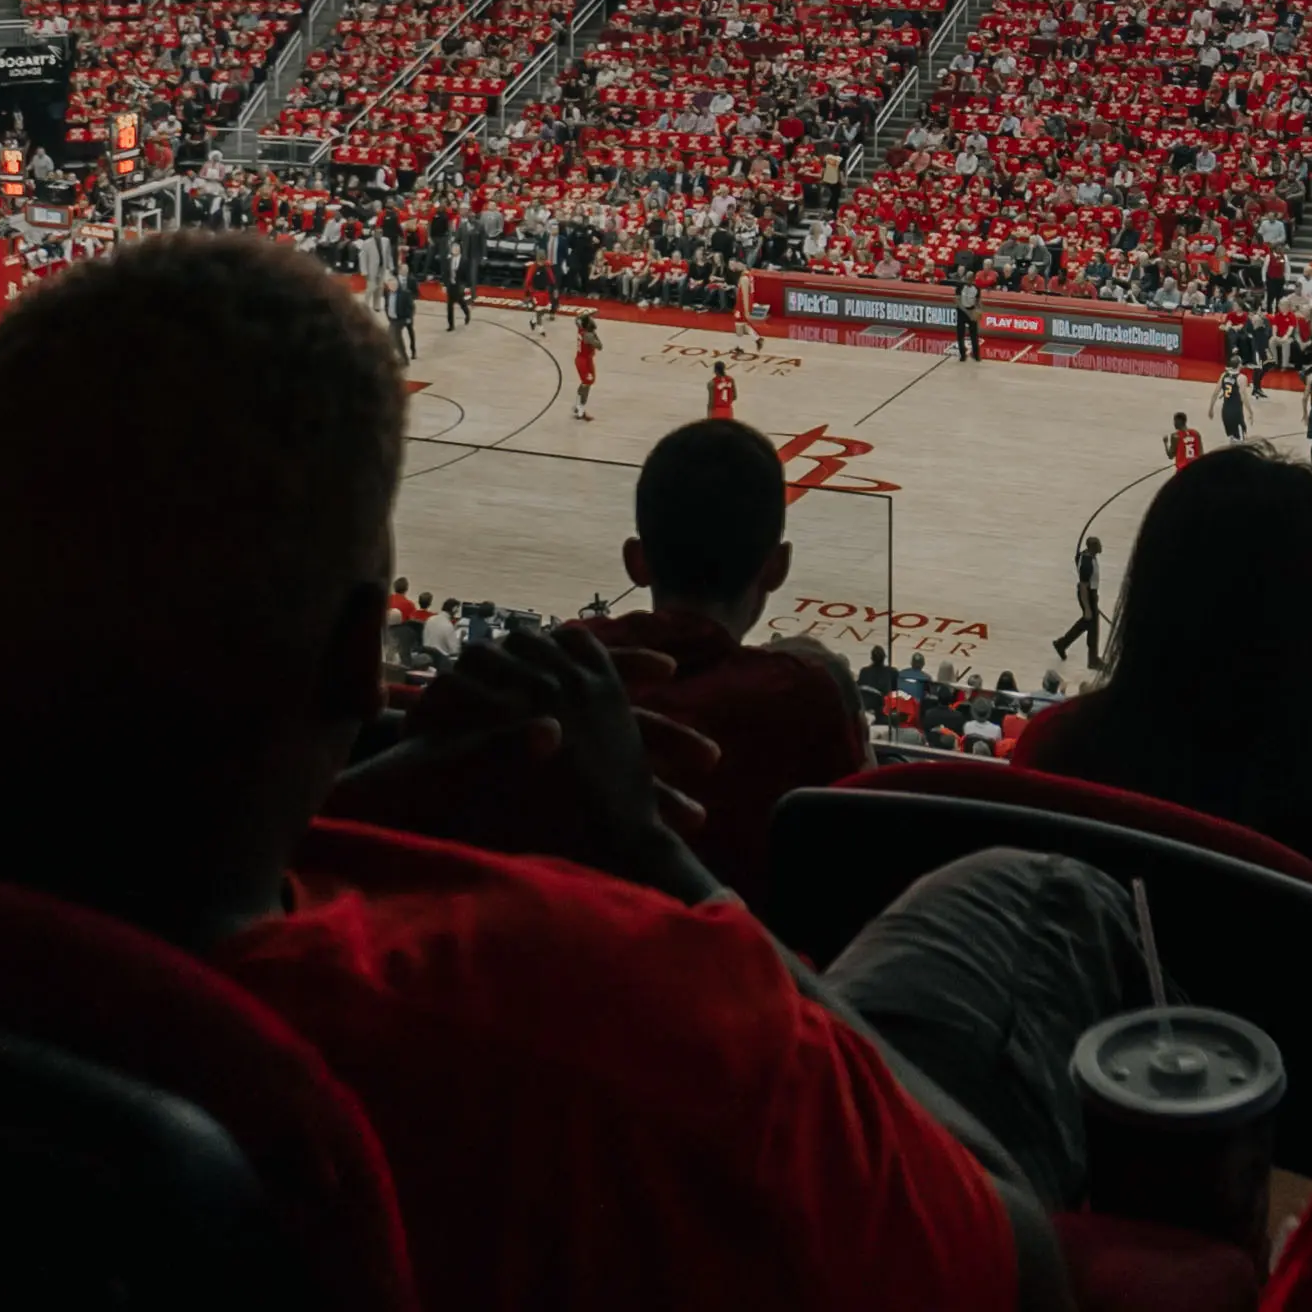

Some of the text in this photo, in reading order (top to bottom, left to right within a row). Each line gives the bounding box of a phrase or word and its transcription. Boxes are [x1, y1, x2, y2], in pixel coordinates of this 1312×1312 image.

[9, 68, 42, 77] LOUNGE
[797, 293, 957, 326] Pick'Em PLAYOFFS BRACKET CHALLE
[986, 317, 1038, 330] PLAY NOW
[1052, 319, 1179, 351] NBA.com/BracketChallenge
[660, 343, 802, 367] TOYOTA
[795, 598, 988, 640] TOYOTA
[768, 616, 977, 657] CENTER
